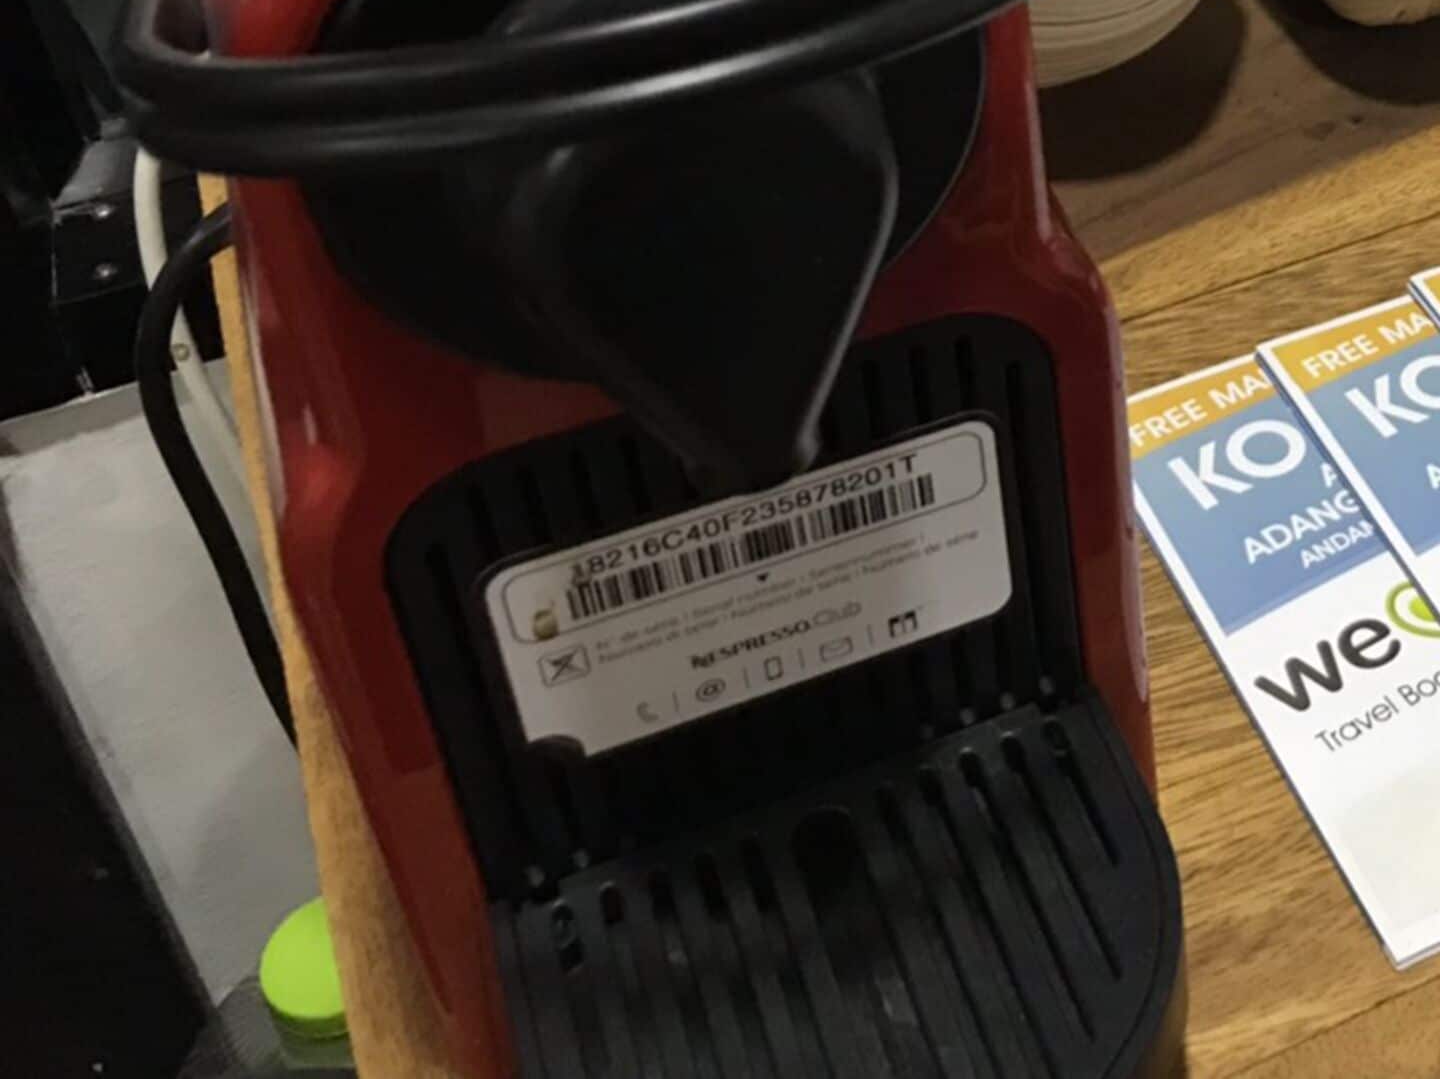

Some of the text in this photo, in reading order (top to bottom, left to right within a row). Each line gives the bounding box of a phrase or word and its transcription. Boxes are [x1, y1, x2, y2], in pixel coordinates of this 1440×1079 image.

[1301, 334, 1380, 379] FREE
[1128, 397, 1208, 448] FREE
[690, 618, 811, 670] NESPRESSO
[1253, 617, 1402, 713] we
[1313, 695, 1399, 754] Travel
